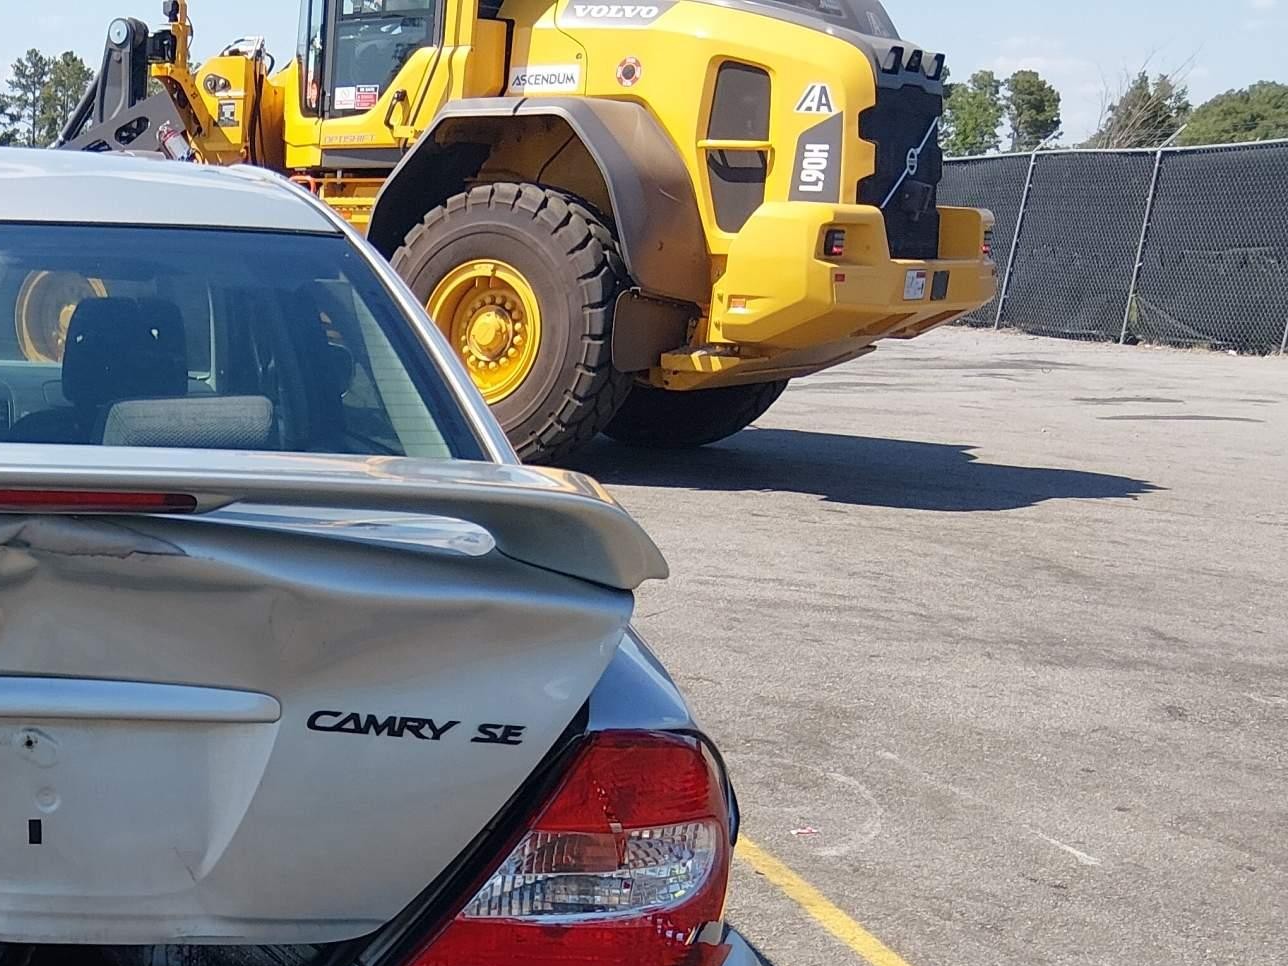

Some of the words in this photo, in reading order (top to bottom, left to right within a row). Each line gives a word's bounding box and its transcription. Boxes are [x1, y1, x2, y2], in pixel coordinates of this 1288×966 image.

[573, 4, 659, 18] VOLVO
[512, 72, 576, 87] ASCENDUM
[798, 143, 830, 192] L90H
[307, 710, 461, 740] CAMRY
[470, 723, 527, 745] SE
